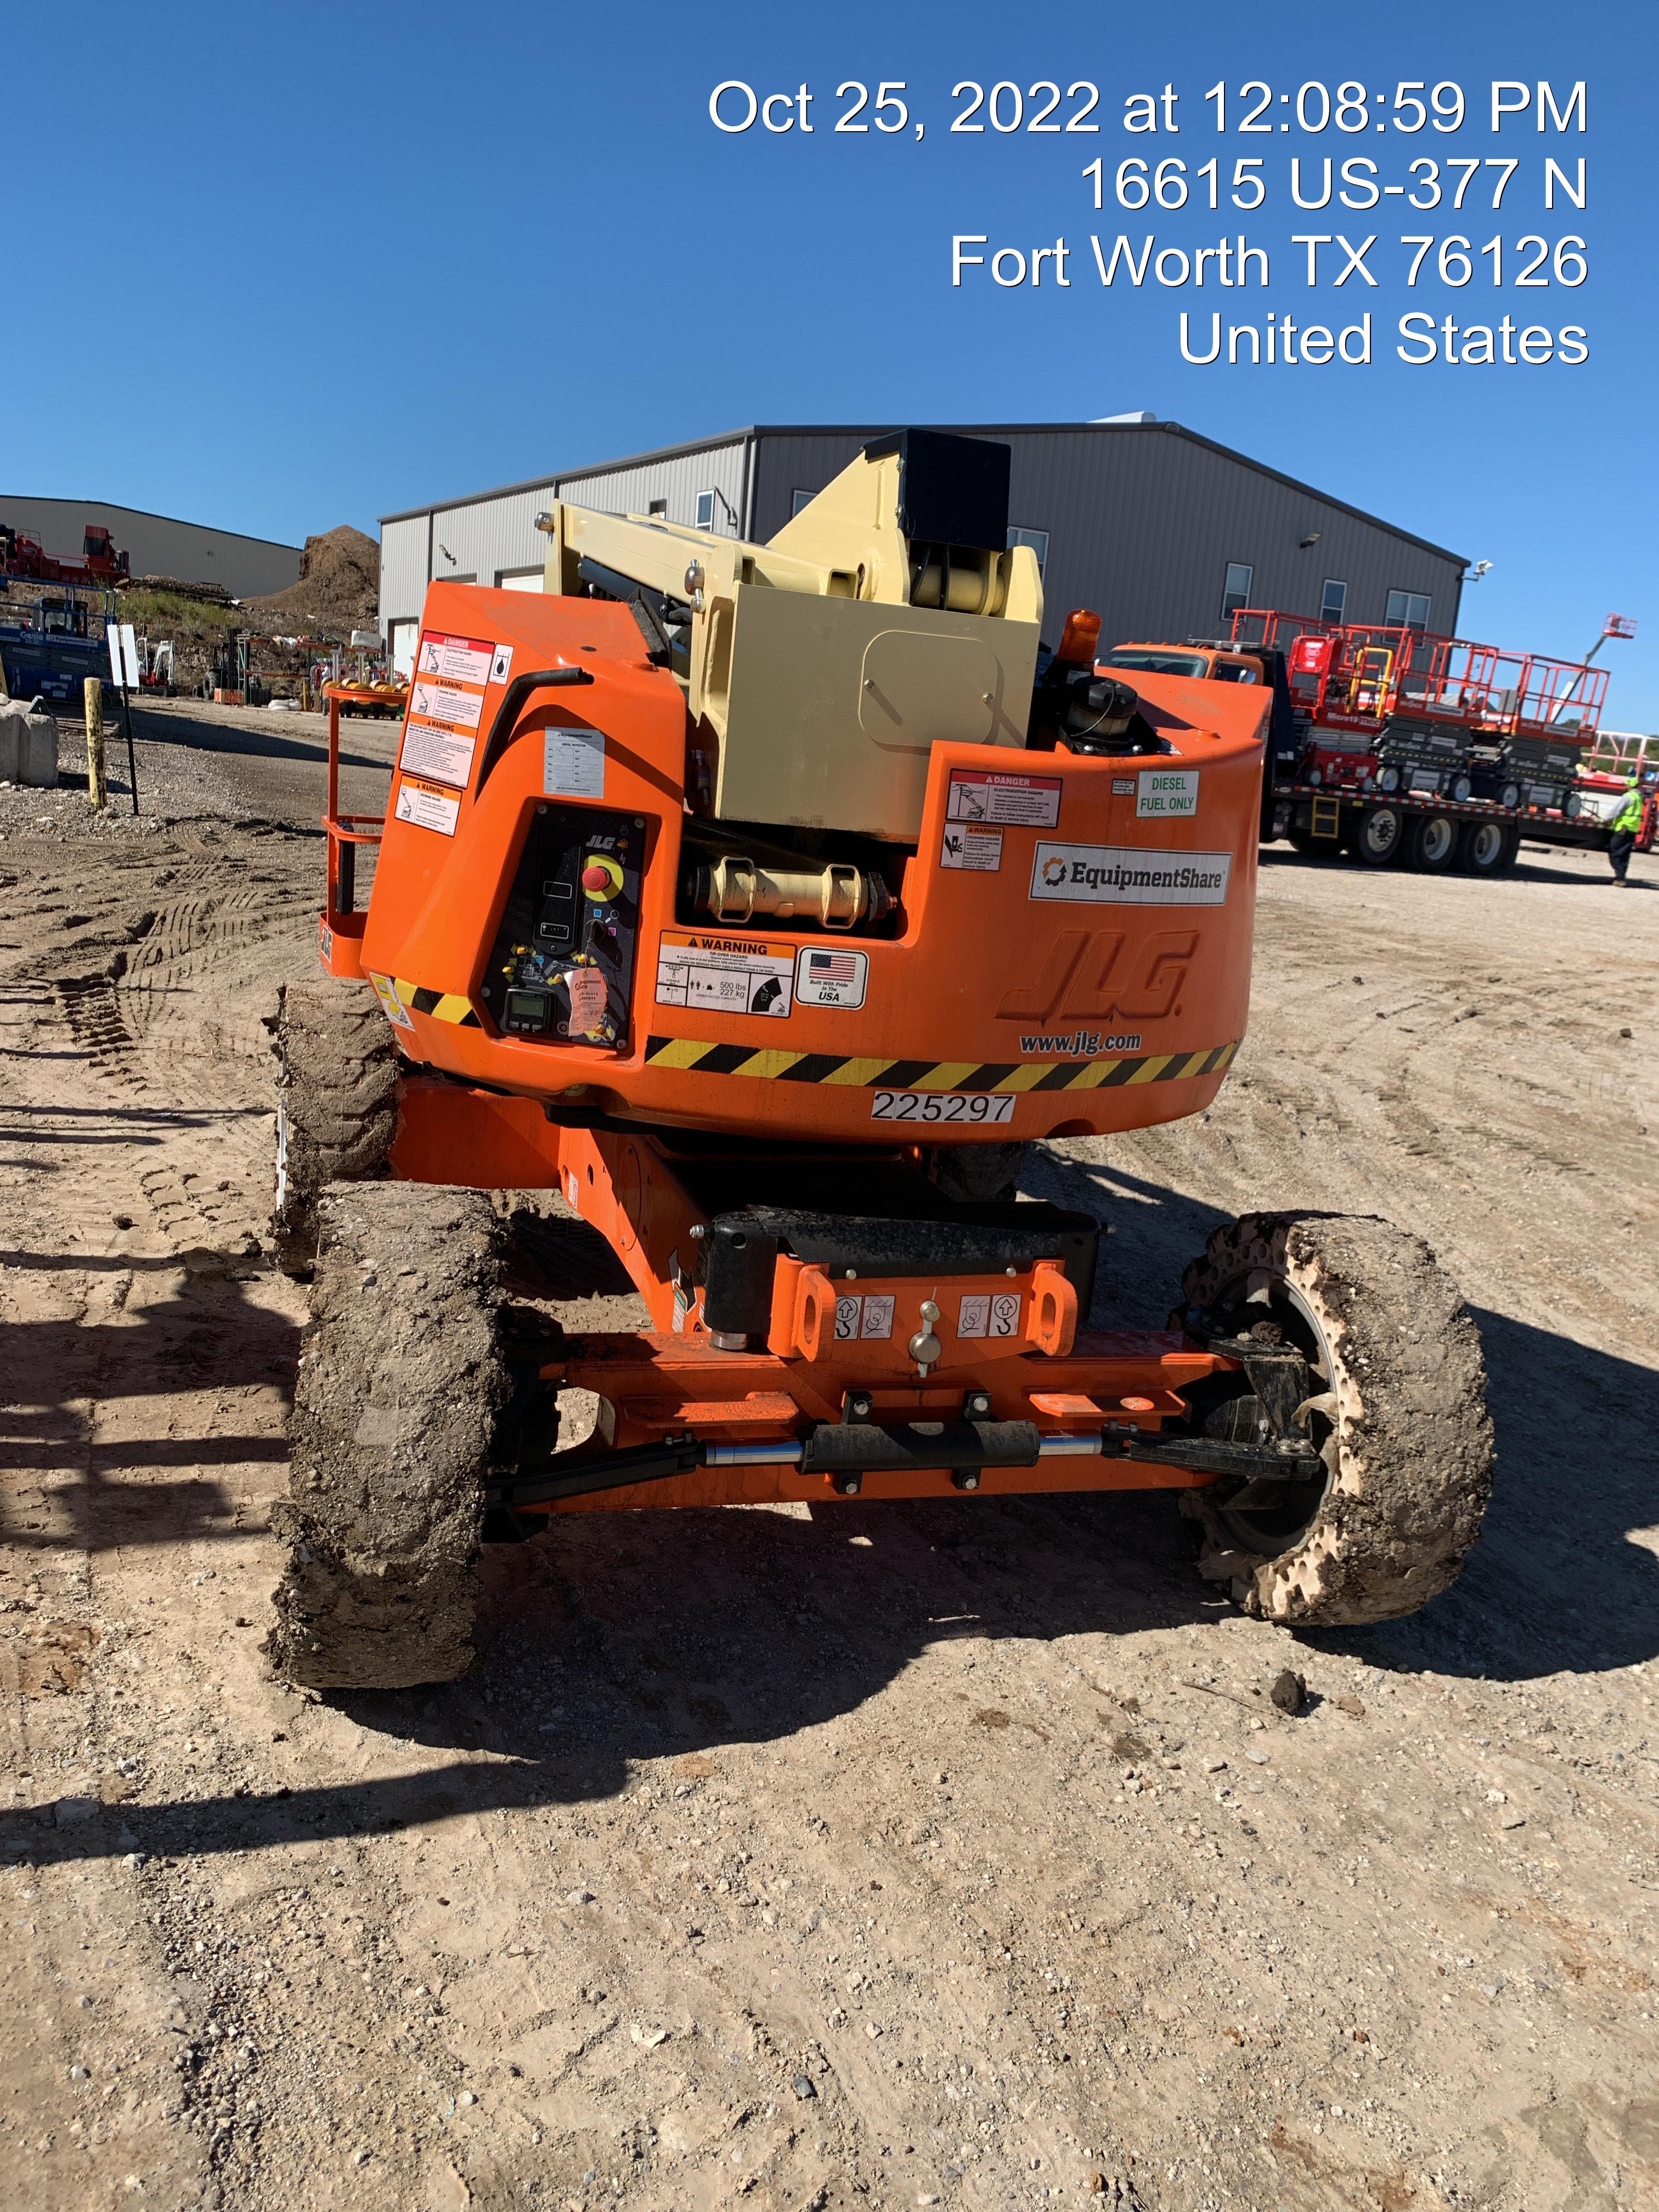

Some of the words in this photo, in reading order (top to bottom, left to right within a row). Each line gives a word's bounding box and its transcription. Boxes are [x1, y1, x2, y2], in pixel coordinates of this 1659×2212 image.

[448, 638, 469, 648] DANGER
[440, 679, 462, 690] WARNING
[1327, 712, 1358, 723] Micro19
[432, 719, 455, 732] WARNING
[994, 776, 1030, 786] DANGER
[1152, 777, 1187, 791] DIESEL
[422, 782, 444, 795] WARNING
[1140, 798, 1166, 811] FUEL
[1169, 797, 1194, 810] ONLY
[585, 835, 616, 850] JLG
[1070, 862, 1222, 890] EquipmentShare
[702, 938, 768, 956] WARNING
[995, 929, 1200, 1021] JLG
[736, 983, 746, 991] lbs
[736, 990, 745, 999] kg
[819, 992, 839, 1002] USA
[1020, 1031, 1141, 1057] www.jlg.com
[871, 1092, 1013, 1121] 225297
